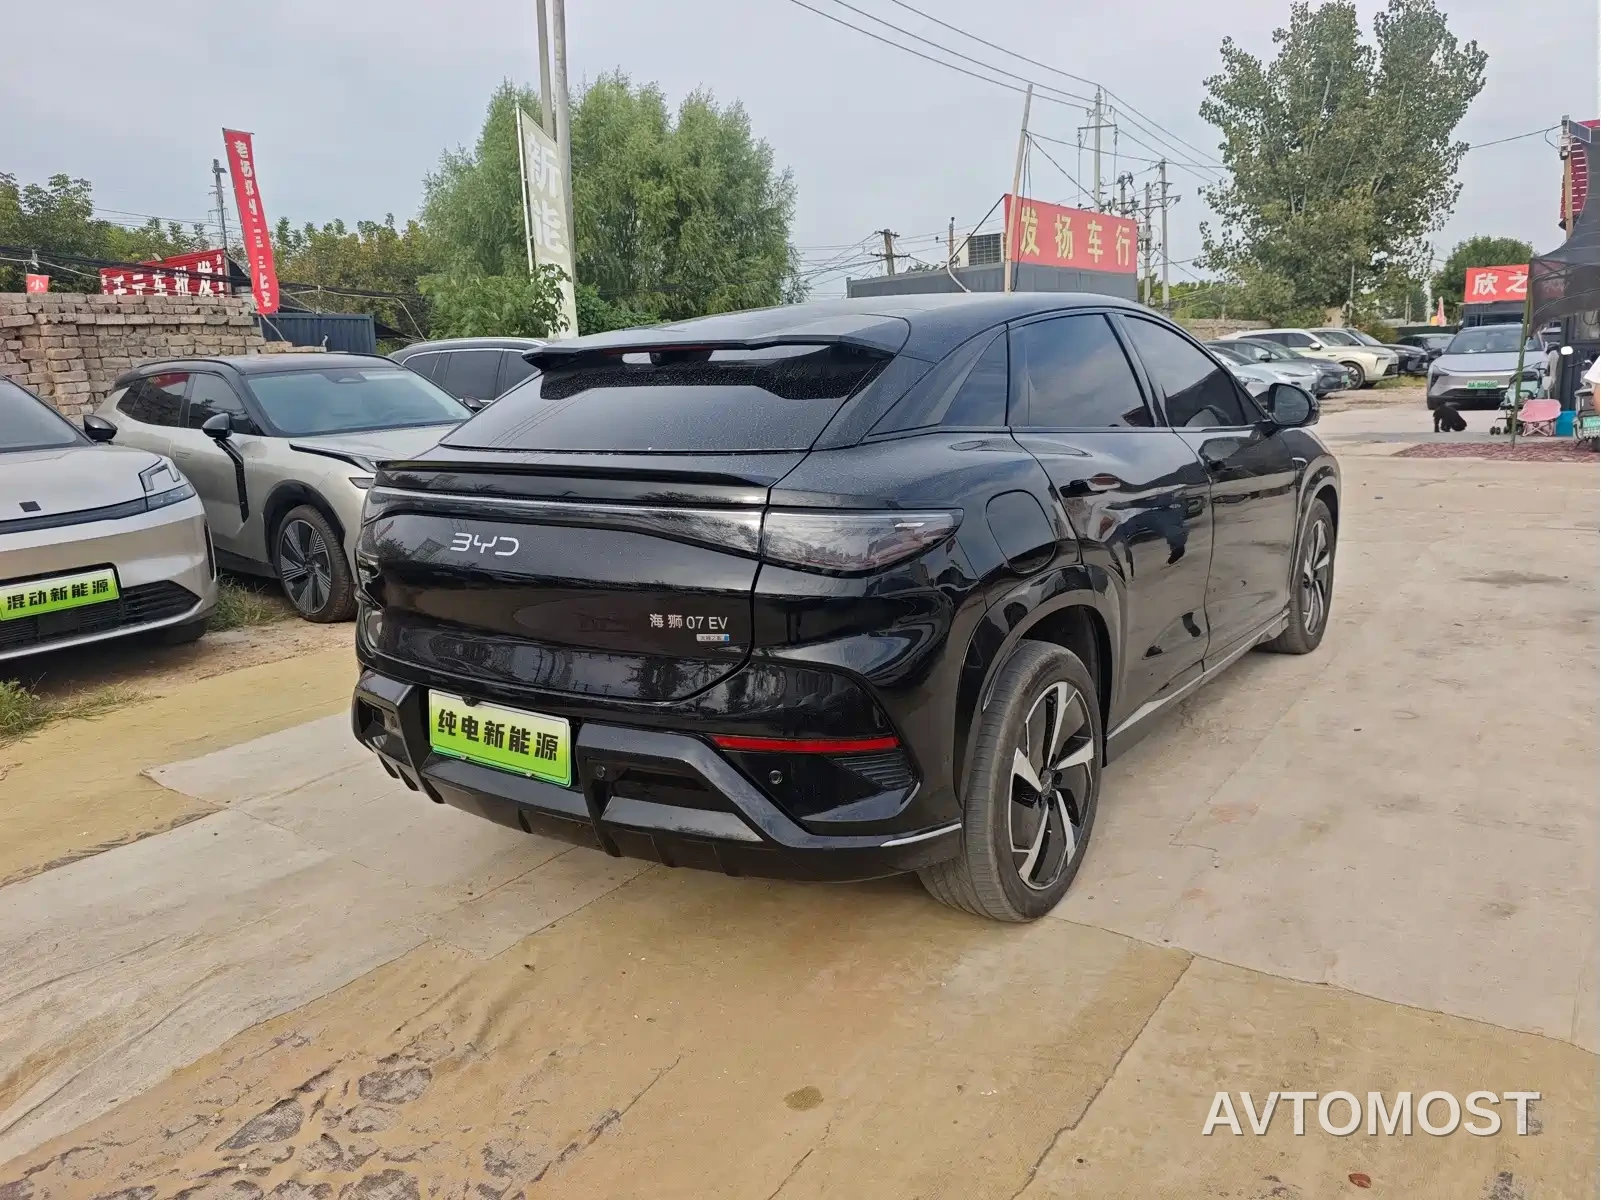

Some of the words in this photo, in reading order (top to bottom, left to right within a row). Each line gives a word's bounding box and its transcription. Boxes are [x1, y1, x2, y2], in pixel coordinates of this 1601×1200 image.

[1020, 206, 1131, 267] 发扬车行
[30, 279, 45, 291] 小
[450, 532, 520, 556] BYD
[7, 578, 109, 611] 混动新能源
[649, 613, 683, 629] 海狮
[686, 616, 704, 630] 07
[708, 616, 729, 630] EV
[437, 708, 559, 762] 纯电新能源
